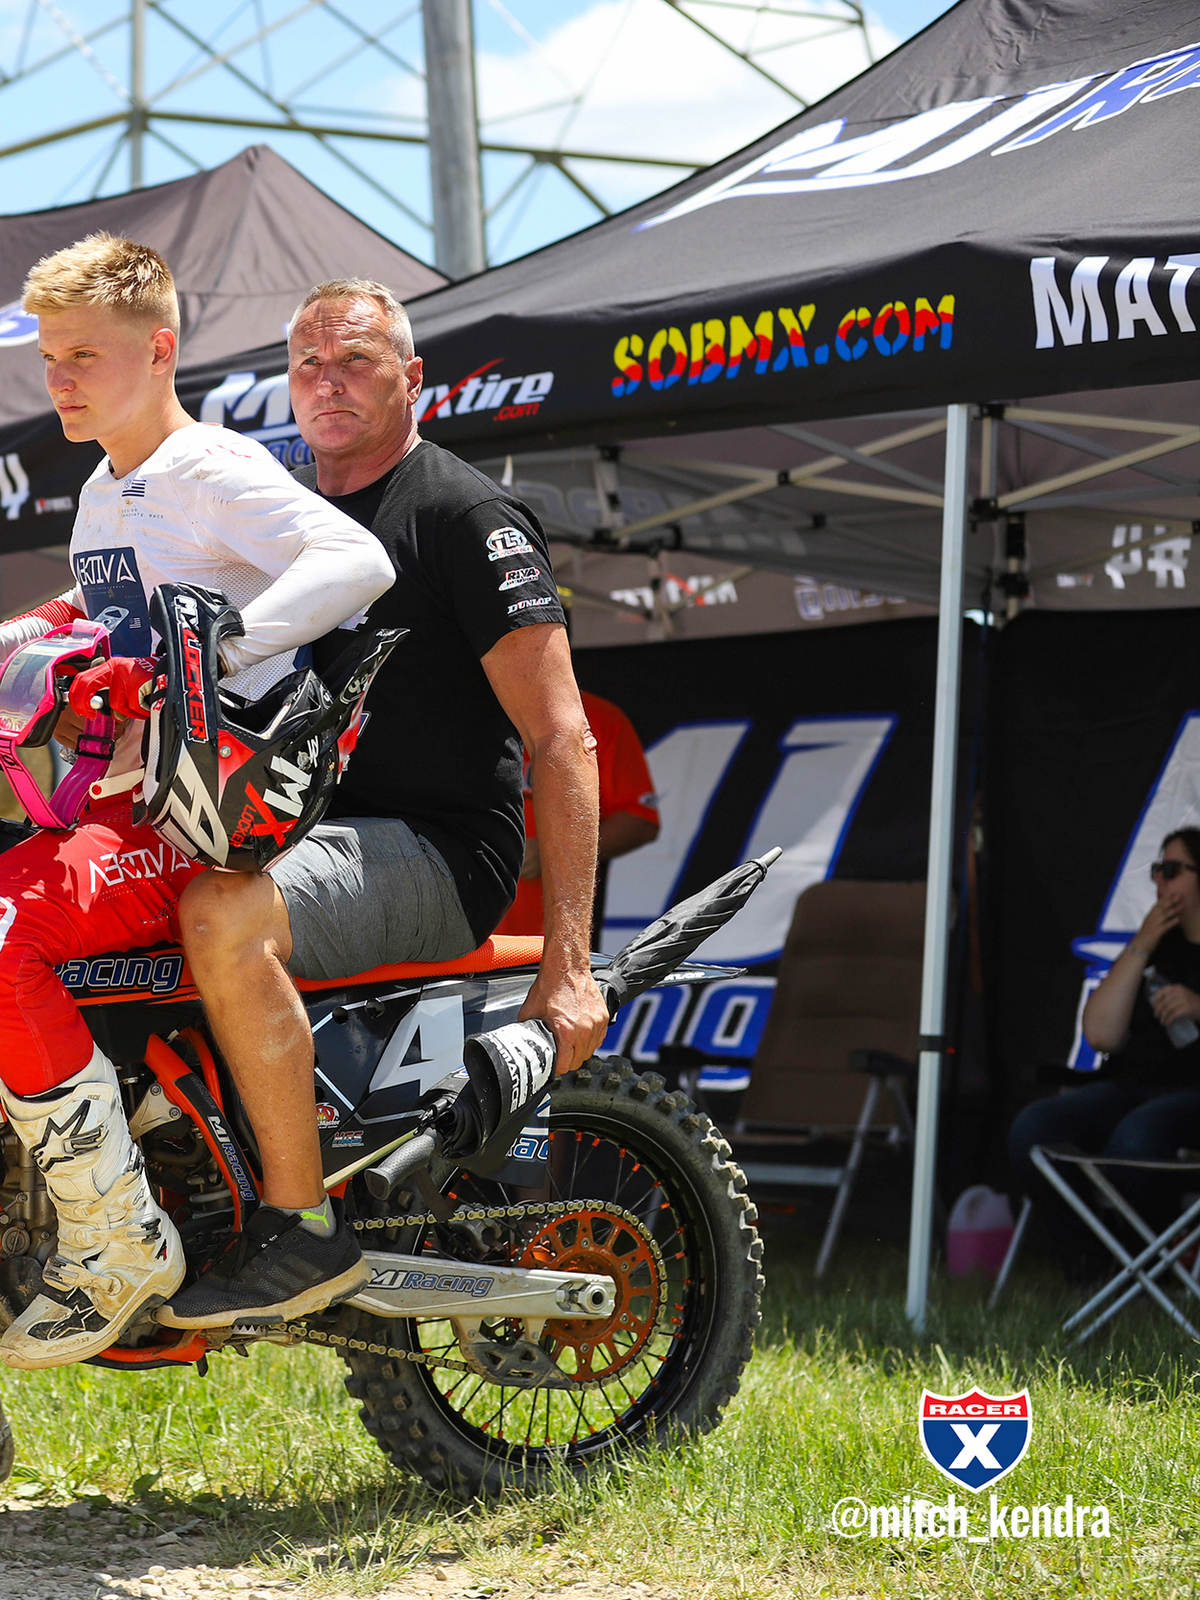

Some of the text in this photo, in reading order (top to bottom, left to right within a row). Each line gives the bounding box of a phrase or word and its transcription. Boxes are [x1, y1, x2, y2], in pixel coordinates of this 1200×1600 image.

[611, 294, 955, 397] SOBMX.COM
[507, 568, 537, 579] RIVA
[506, 597, 551, 614] DUNLOP
[229, 803, 257, 848] LOCKER
[367, 994, 465, 1097] 4
[221, 1142, 256, 1201] Racing
[403, 1272, 494, 1297] Racing
